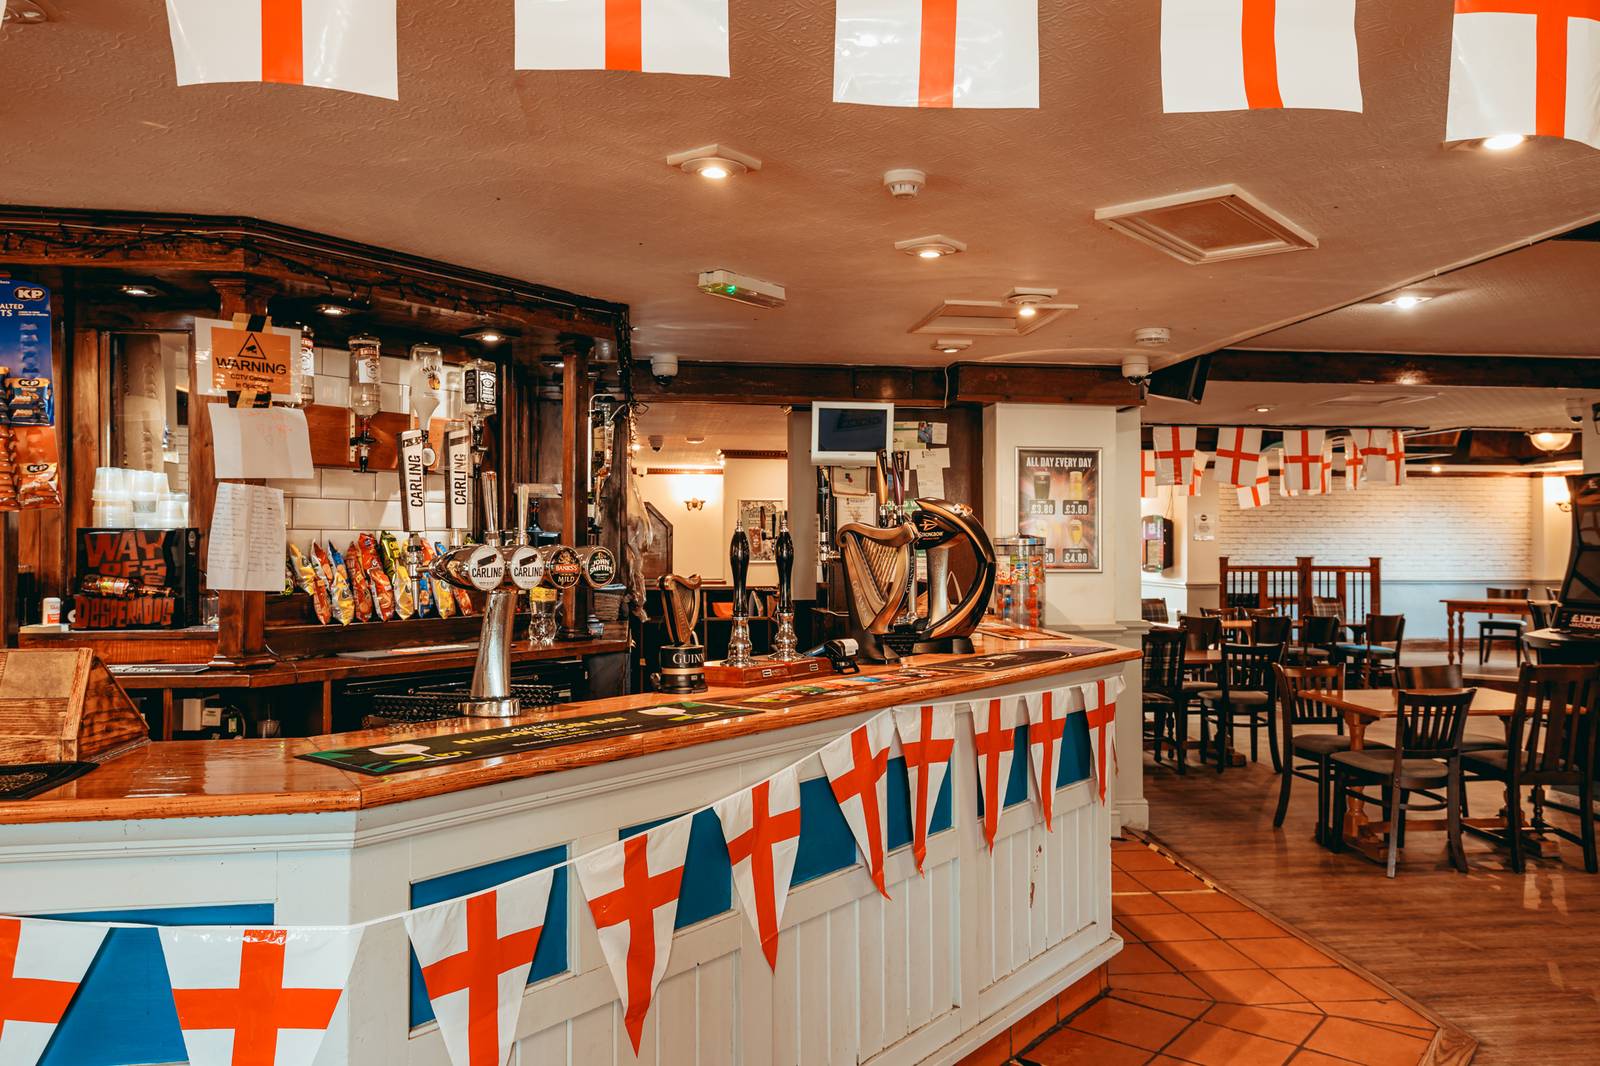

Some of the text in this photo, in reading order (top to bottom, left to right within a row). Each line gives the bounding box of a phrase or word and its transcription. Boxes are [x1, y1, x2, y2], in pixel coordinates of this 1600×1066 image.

[18, 289, 43, 299] KP
[215, 357, 287, 375] WARNING
[230, 373, 249, 382] CCTV
[1026, 457, 1092, 468] ALL DAY EVERY DAY
[407, 454, 424, 508] CARLING
[454, 453, 467, 505] CARLING
[1064, 504, 1088, 514] £3.60
[85, 530, 167, 568] WAY
[593, 559, 610, 567] JOHN
[1064, 552, 1088, 563] £4.00
[472, 566, 502, 578] CARLING
[513, 566, 543, 577] CARLING
[589, 566, 613, 575] SMITH'S
[557, 576, 575, 584] MILD
